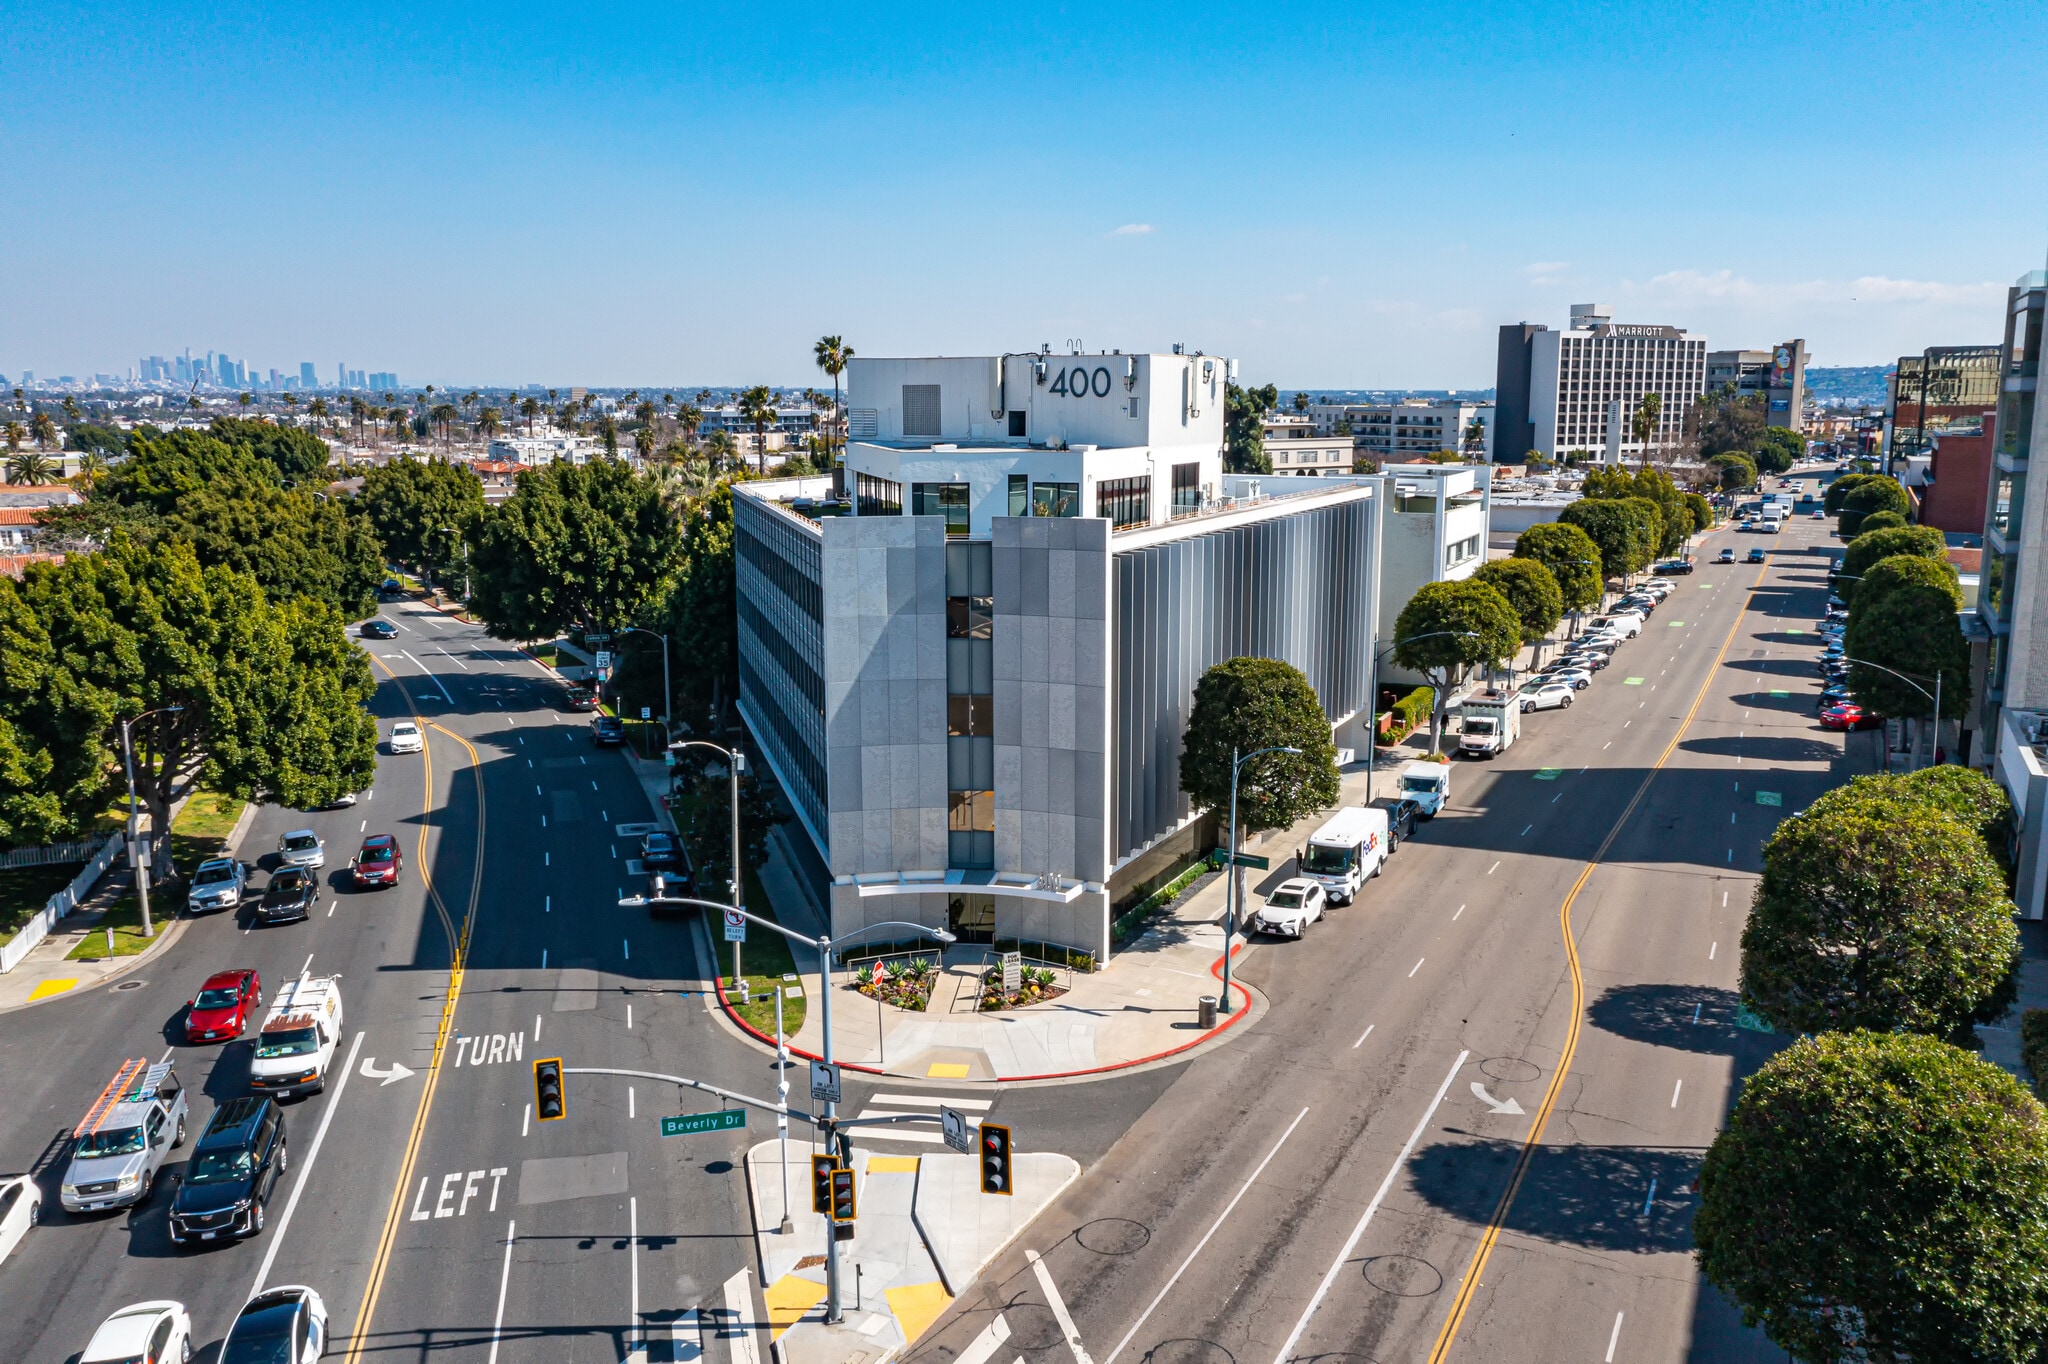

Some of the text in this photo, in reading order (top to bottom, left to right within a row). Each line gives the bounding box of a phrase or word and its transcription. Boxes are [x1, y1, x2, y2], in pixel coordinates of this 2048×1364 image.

[1618, 326, 1663, 337] MARRIOTT
[1049, 366, 1112, 398] 400
[1362, 832, 1378, 858] FedEx
[454, 1031, 525, 1068] TURN
[667, 1115, 741, 1132] Beverly Dr
[409, 1167, 508, 1221] LEFT
